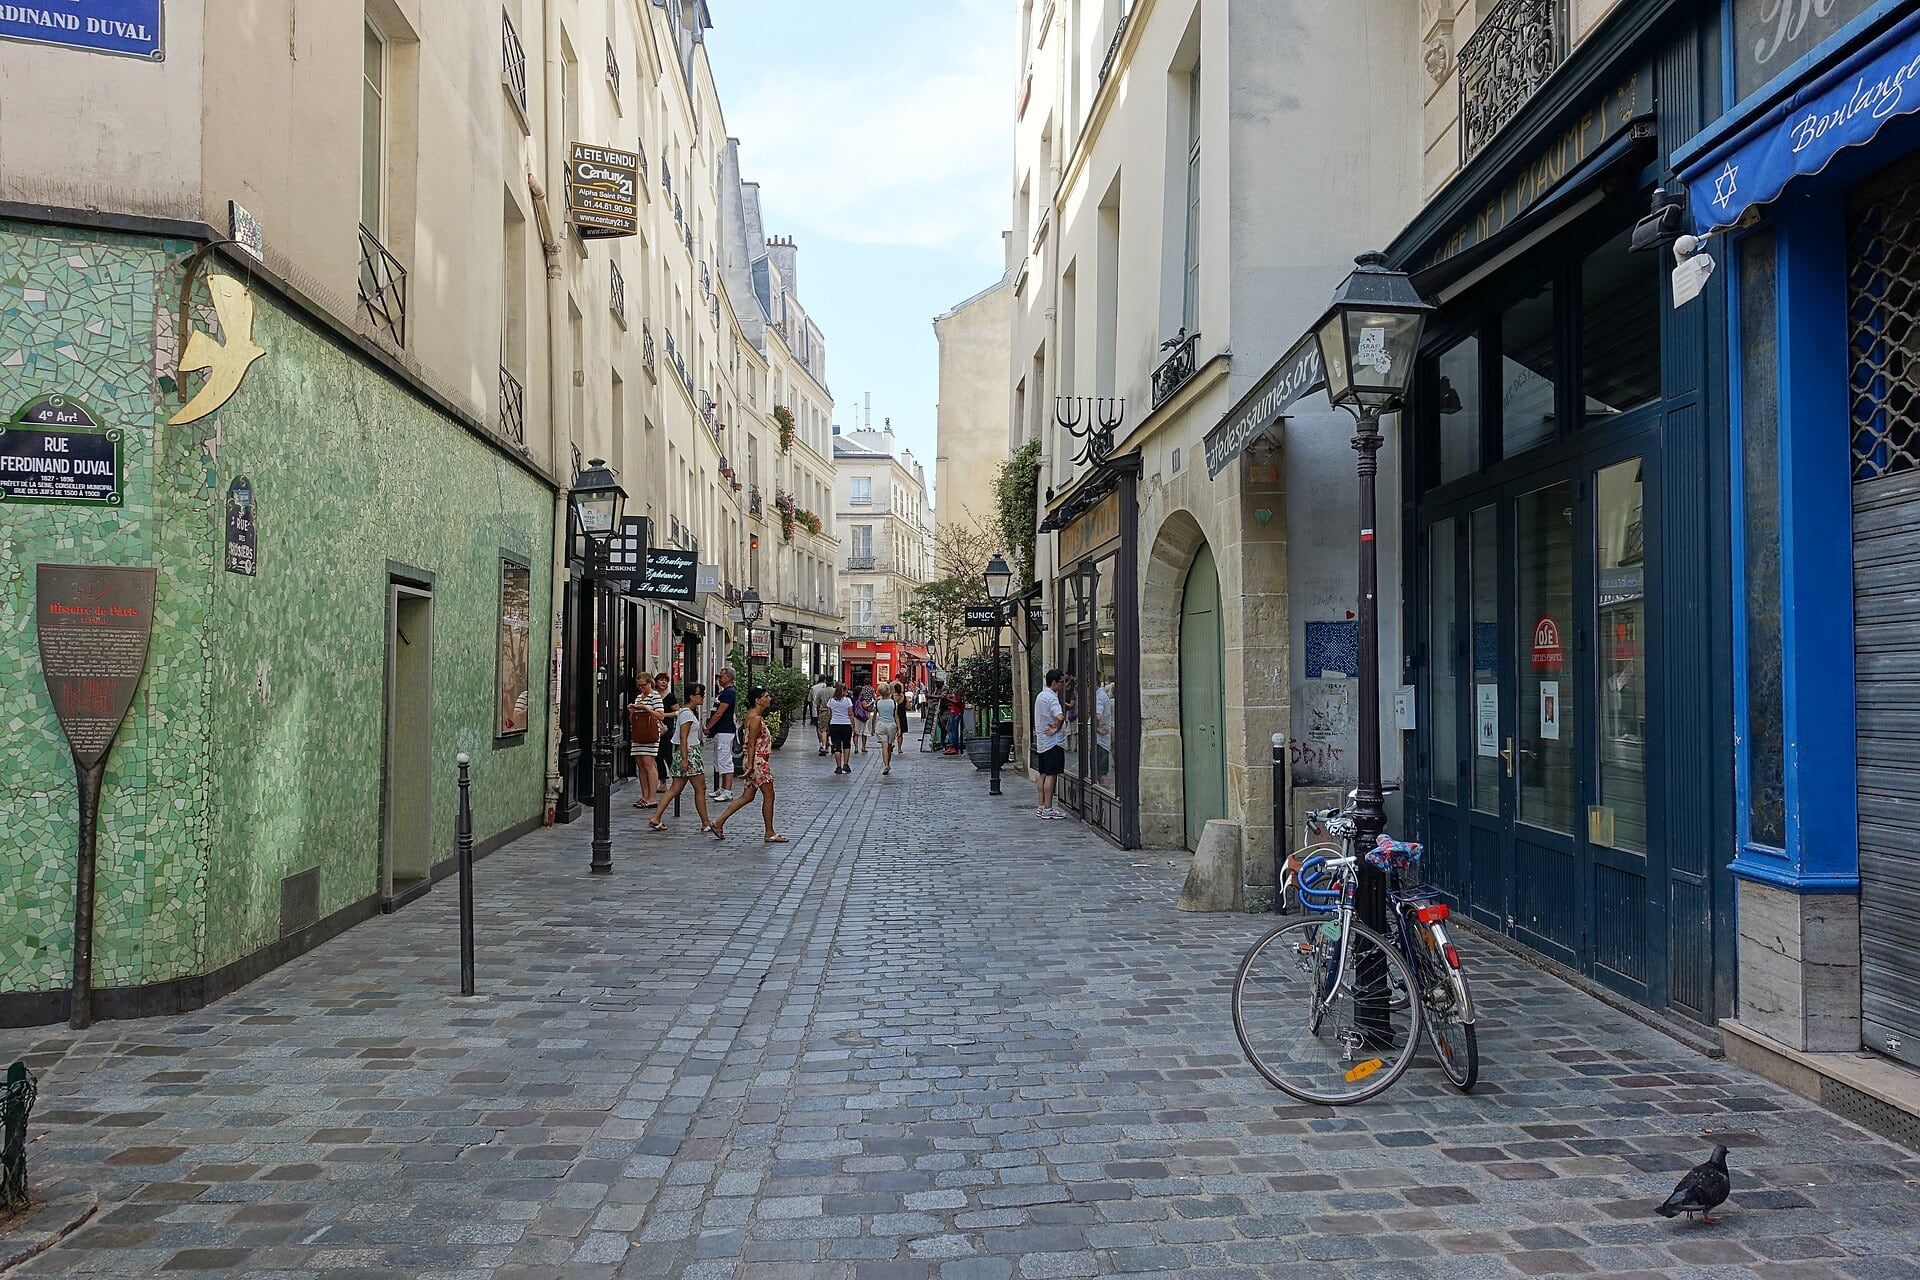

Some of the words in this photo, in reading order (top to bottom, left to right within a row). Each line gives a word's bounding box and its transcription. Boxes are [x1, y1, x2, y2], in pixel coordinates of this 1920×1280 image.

[87, 17, 151, 41] DUVAL
[574, 147, 582, 158] A
[584, 149, 602, 162] ETE
[604, 152, 636, 168] VENDU
[578, 188, 598, 197] Alpha
[599, 191, 616, 200] Saint
[580, 214, 630, 228] www.century21.fr
[44, 437, 69, 452] RUE
[0, 456, 70, 474] FERDINAND
[74, 460, 113, 476] DUVAL
[236, 518, 248, 531] RUE
[656, 584, 689, 594] Marais
[1539, 625, 1553, 645] OSE
